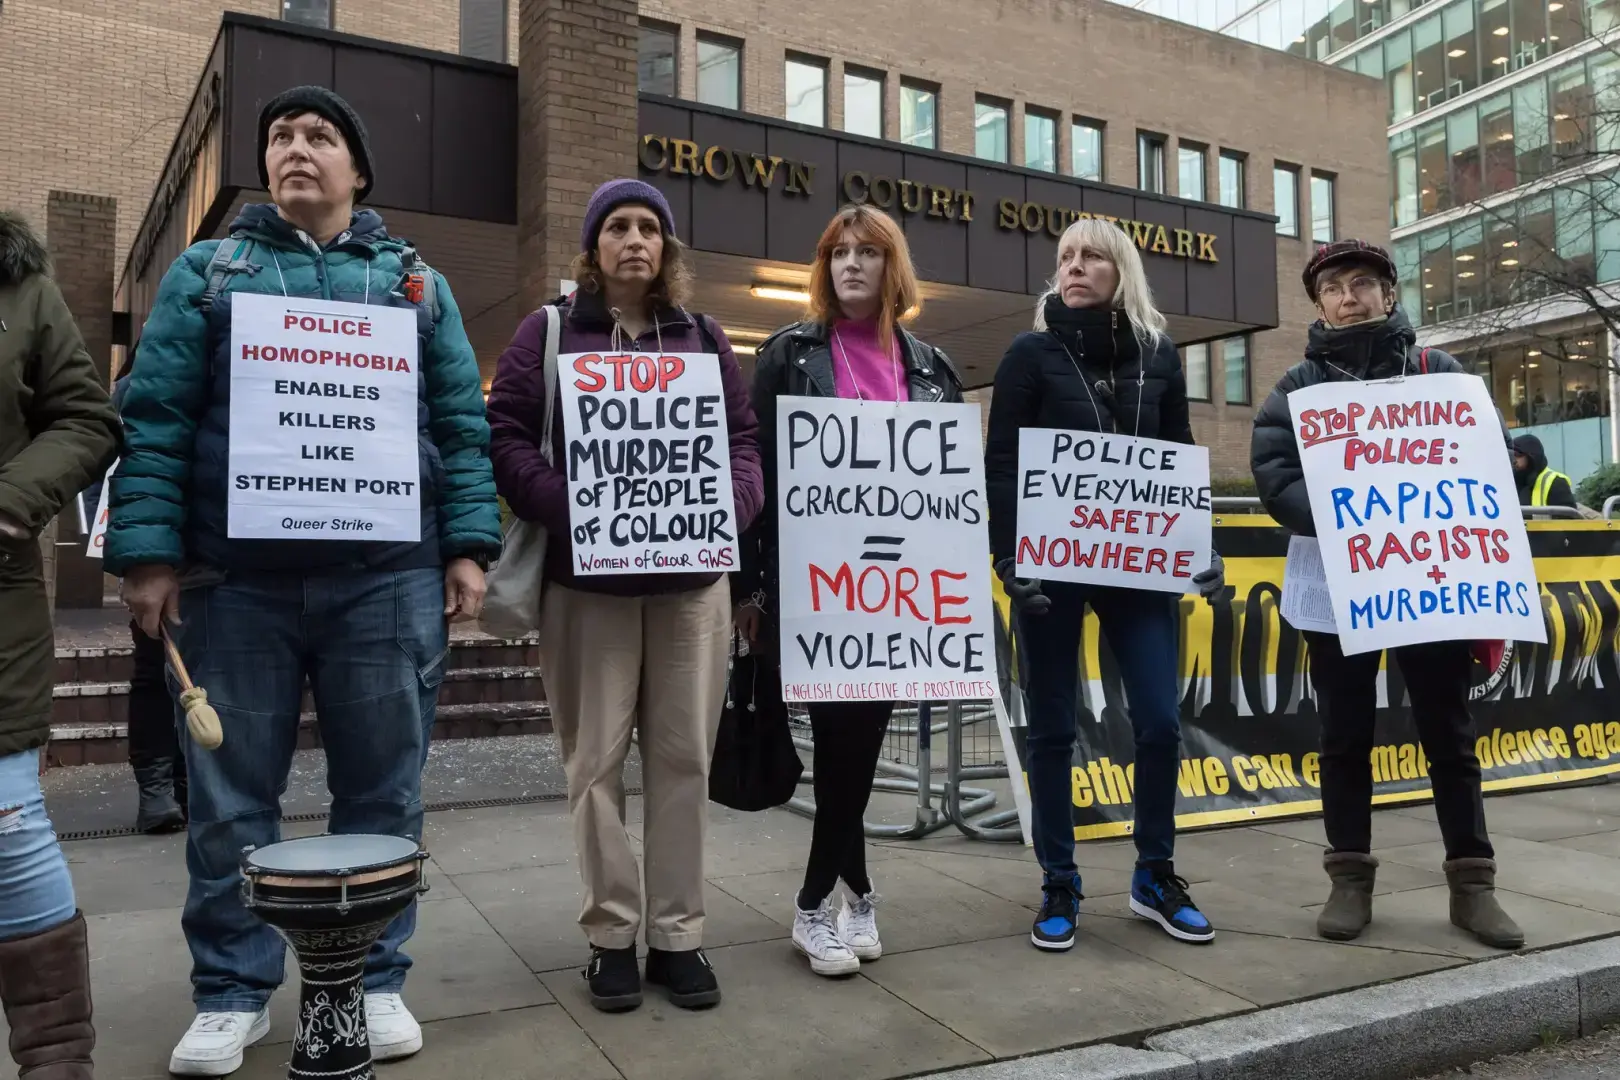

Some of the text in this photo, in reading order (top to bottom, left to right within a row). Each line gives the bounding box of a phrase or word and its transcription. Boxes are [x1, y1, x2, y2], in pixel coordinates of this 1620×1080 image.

[638, 133, 1219, 263] CROWN COURT SOUWARK
[284, 315, 372, 338] POLICE
[241, 344, 411, 373] HOMOPHOBIA
[573, 354, 685, 393] STOP
[274, 380, 380, 401] ENABLES
[279, 411, 376, 431] KILLERS
[578, 394, 720, 435] POLICE
[1300, 400, 1477, 441] STOP ARMING
[301, 445, 354, 461] LIKE
[569, 434, 722, 482] MURDER
[788, 410, 971, 476] POLICE
[1052, 433, 1177, 471] POLICE
[1344, 438, 1459, 470] POLICE:
[235, 475, 415, 496] STEPHEN PORT
[575, 476, 719, 511] OF PEOPLE
[786, 484, 980, 525] CRACKDOWNS
[1023, 469, 1211, 511] EVERYWHERE
[1331, 478, 1500, 530] RAPISTS
[281, 517, 373, 531] Queer Strike
[573, 509, 734, 547] OF COLOUR
[1069, 504, 1180, 537] SAFETY
[698, 547, 734, 569] GWS
[1016, 535, 1194, 578] NOWHERE
[1347, 525, 1510, 573] RACISTS
[808, 561, 972, 626] MORE
[1350, 580, 1530, 630] MURDERERS
[796, 625, 984, 674] VIOLENCE
[785, 680, 994, 700] ENGLISH COLLECTIVE OF PROSTITUTES
[1178, 756, 1230, 798] we
[1231, 752, 1301, 792] can
[1371, 741, 1431, 783] mal
[1475, 726, 1571, 770] olence
